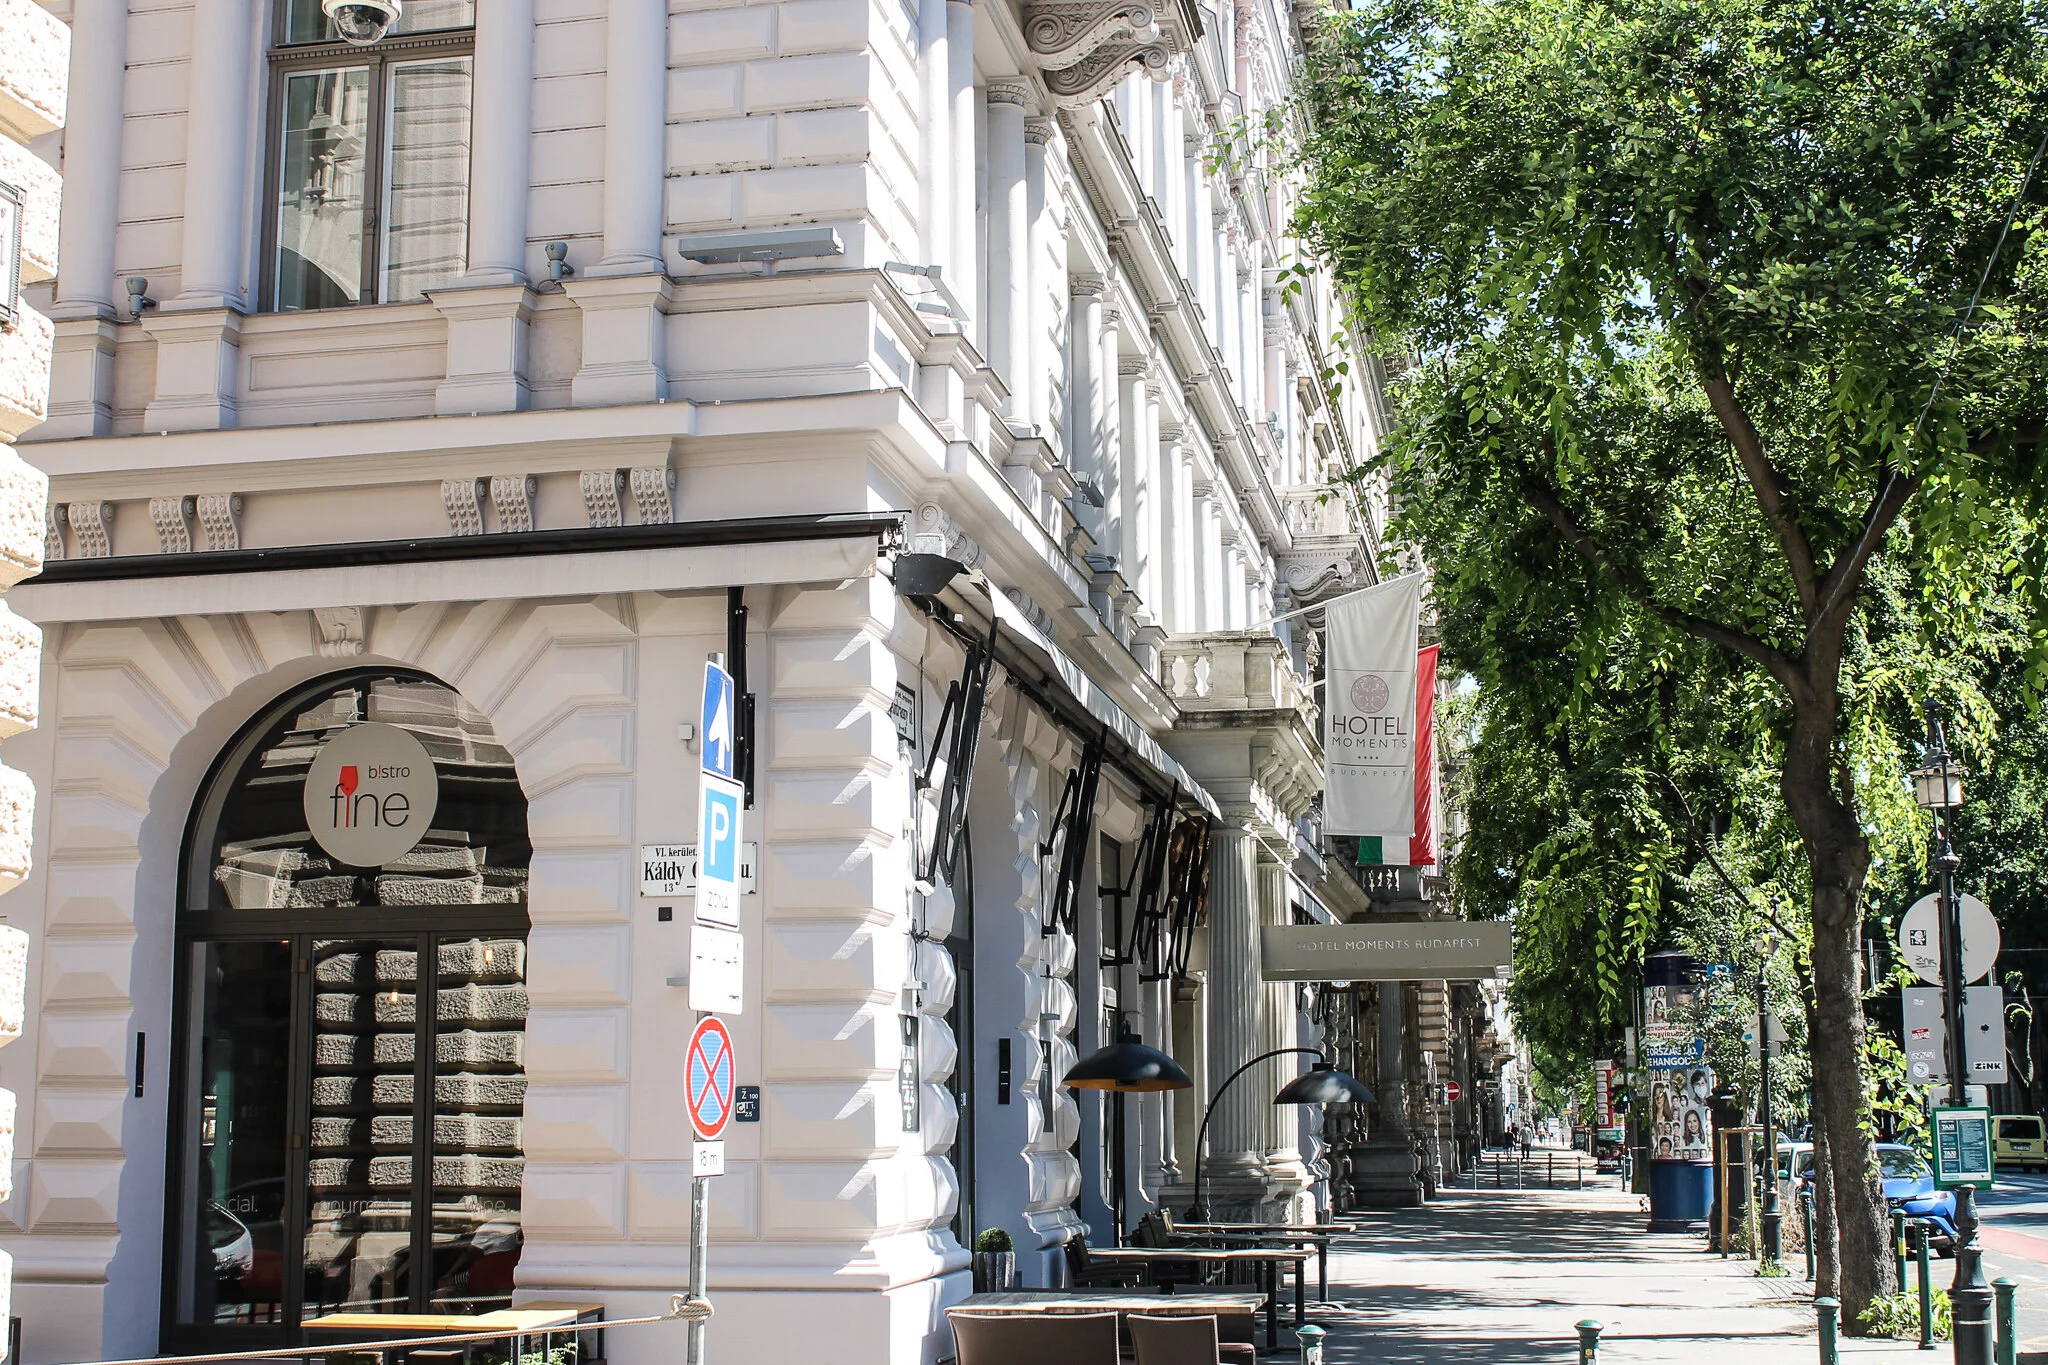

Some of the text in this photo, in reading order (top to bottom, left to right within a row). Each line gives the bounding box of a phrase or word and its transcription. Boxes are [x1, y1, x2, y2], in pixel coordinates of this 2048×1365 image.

[1332, 714, 1408, 736] HOTEL
[1332, 736, 1408, 749] MOMENTS
[1330, 768, 1408, 777] BUDAPEST
[329, 781, 410, 829] fine
[710, 800, 730, 867] P
[655, 847, 667, 857] VI.
[643, 860, 686, 886] Káldy
[663, 882, 675, 893] 13
[1297, 938, 1481, 951] HOTEL MOMENTS BUDAPEST
[710, 1154, 718, 1166] m
[206, 1194, 259, 1213] social.
